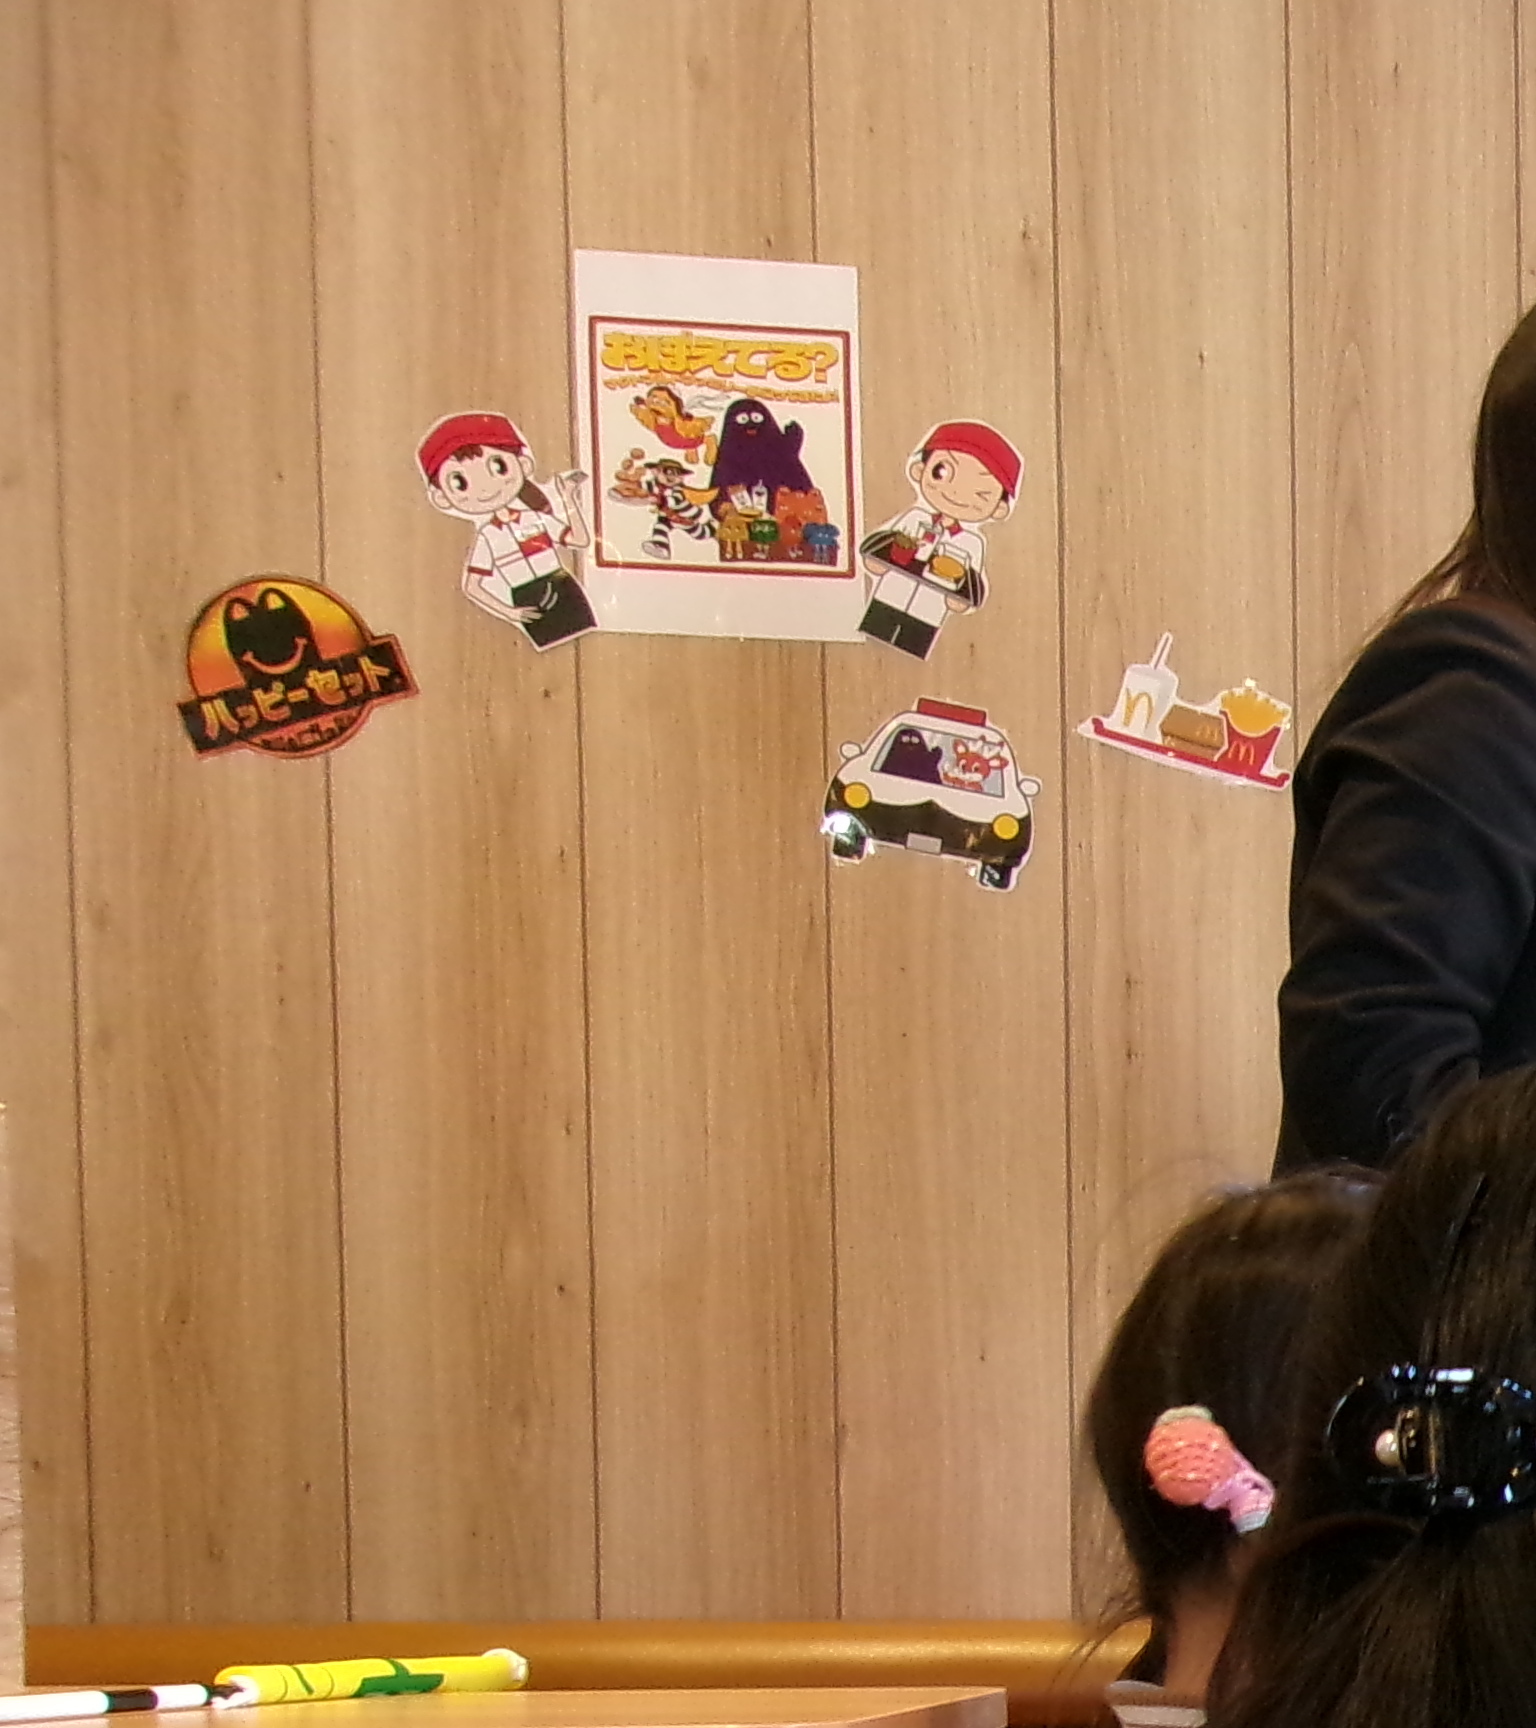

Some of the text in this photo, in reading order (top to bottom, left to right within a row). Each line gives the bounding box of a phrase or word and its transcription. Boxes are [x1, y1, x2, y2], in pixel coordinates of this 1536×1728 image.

[201, 656, 391, 740] ハッピーセット
